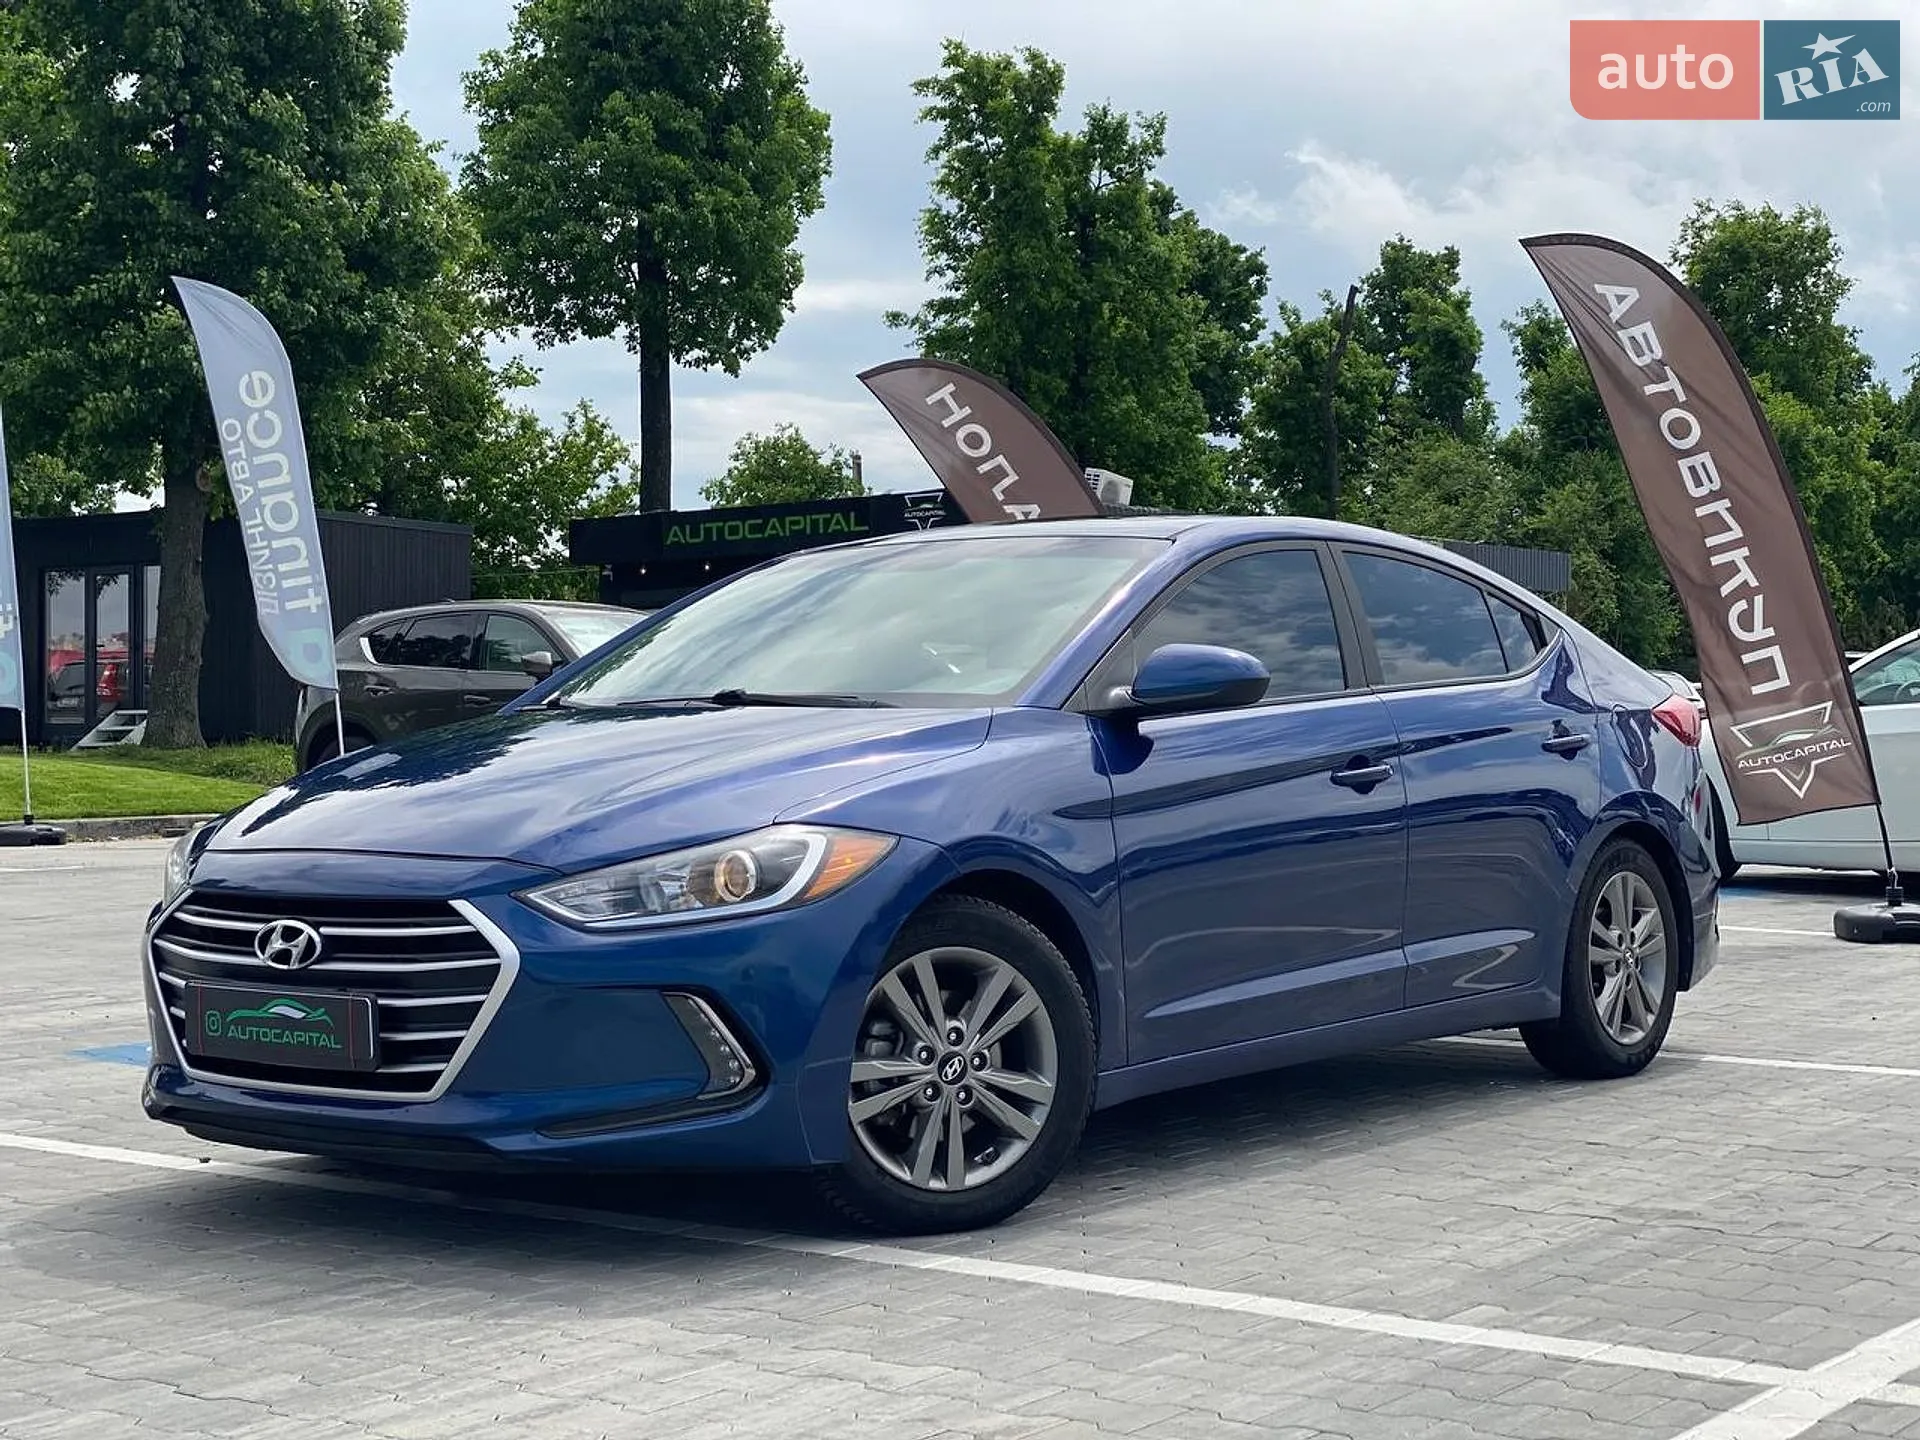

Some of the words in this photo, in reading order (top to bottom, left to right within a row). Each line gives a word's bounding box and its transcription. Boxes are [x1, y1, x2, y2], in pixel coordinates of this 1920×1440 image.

[1595, 282, 1791, 695] АВТОВИКУП
[667, 511, 869, 545] AUTOCAPITAL
[1738, 738, 1852, 769] AUTOCAPITAL
[226, 1024, 343, 1050] AUTOCAPITAL
